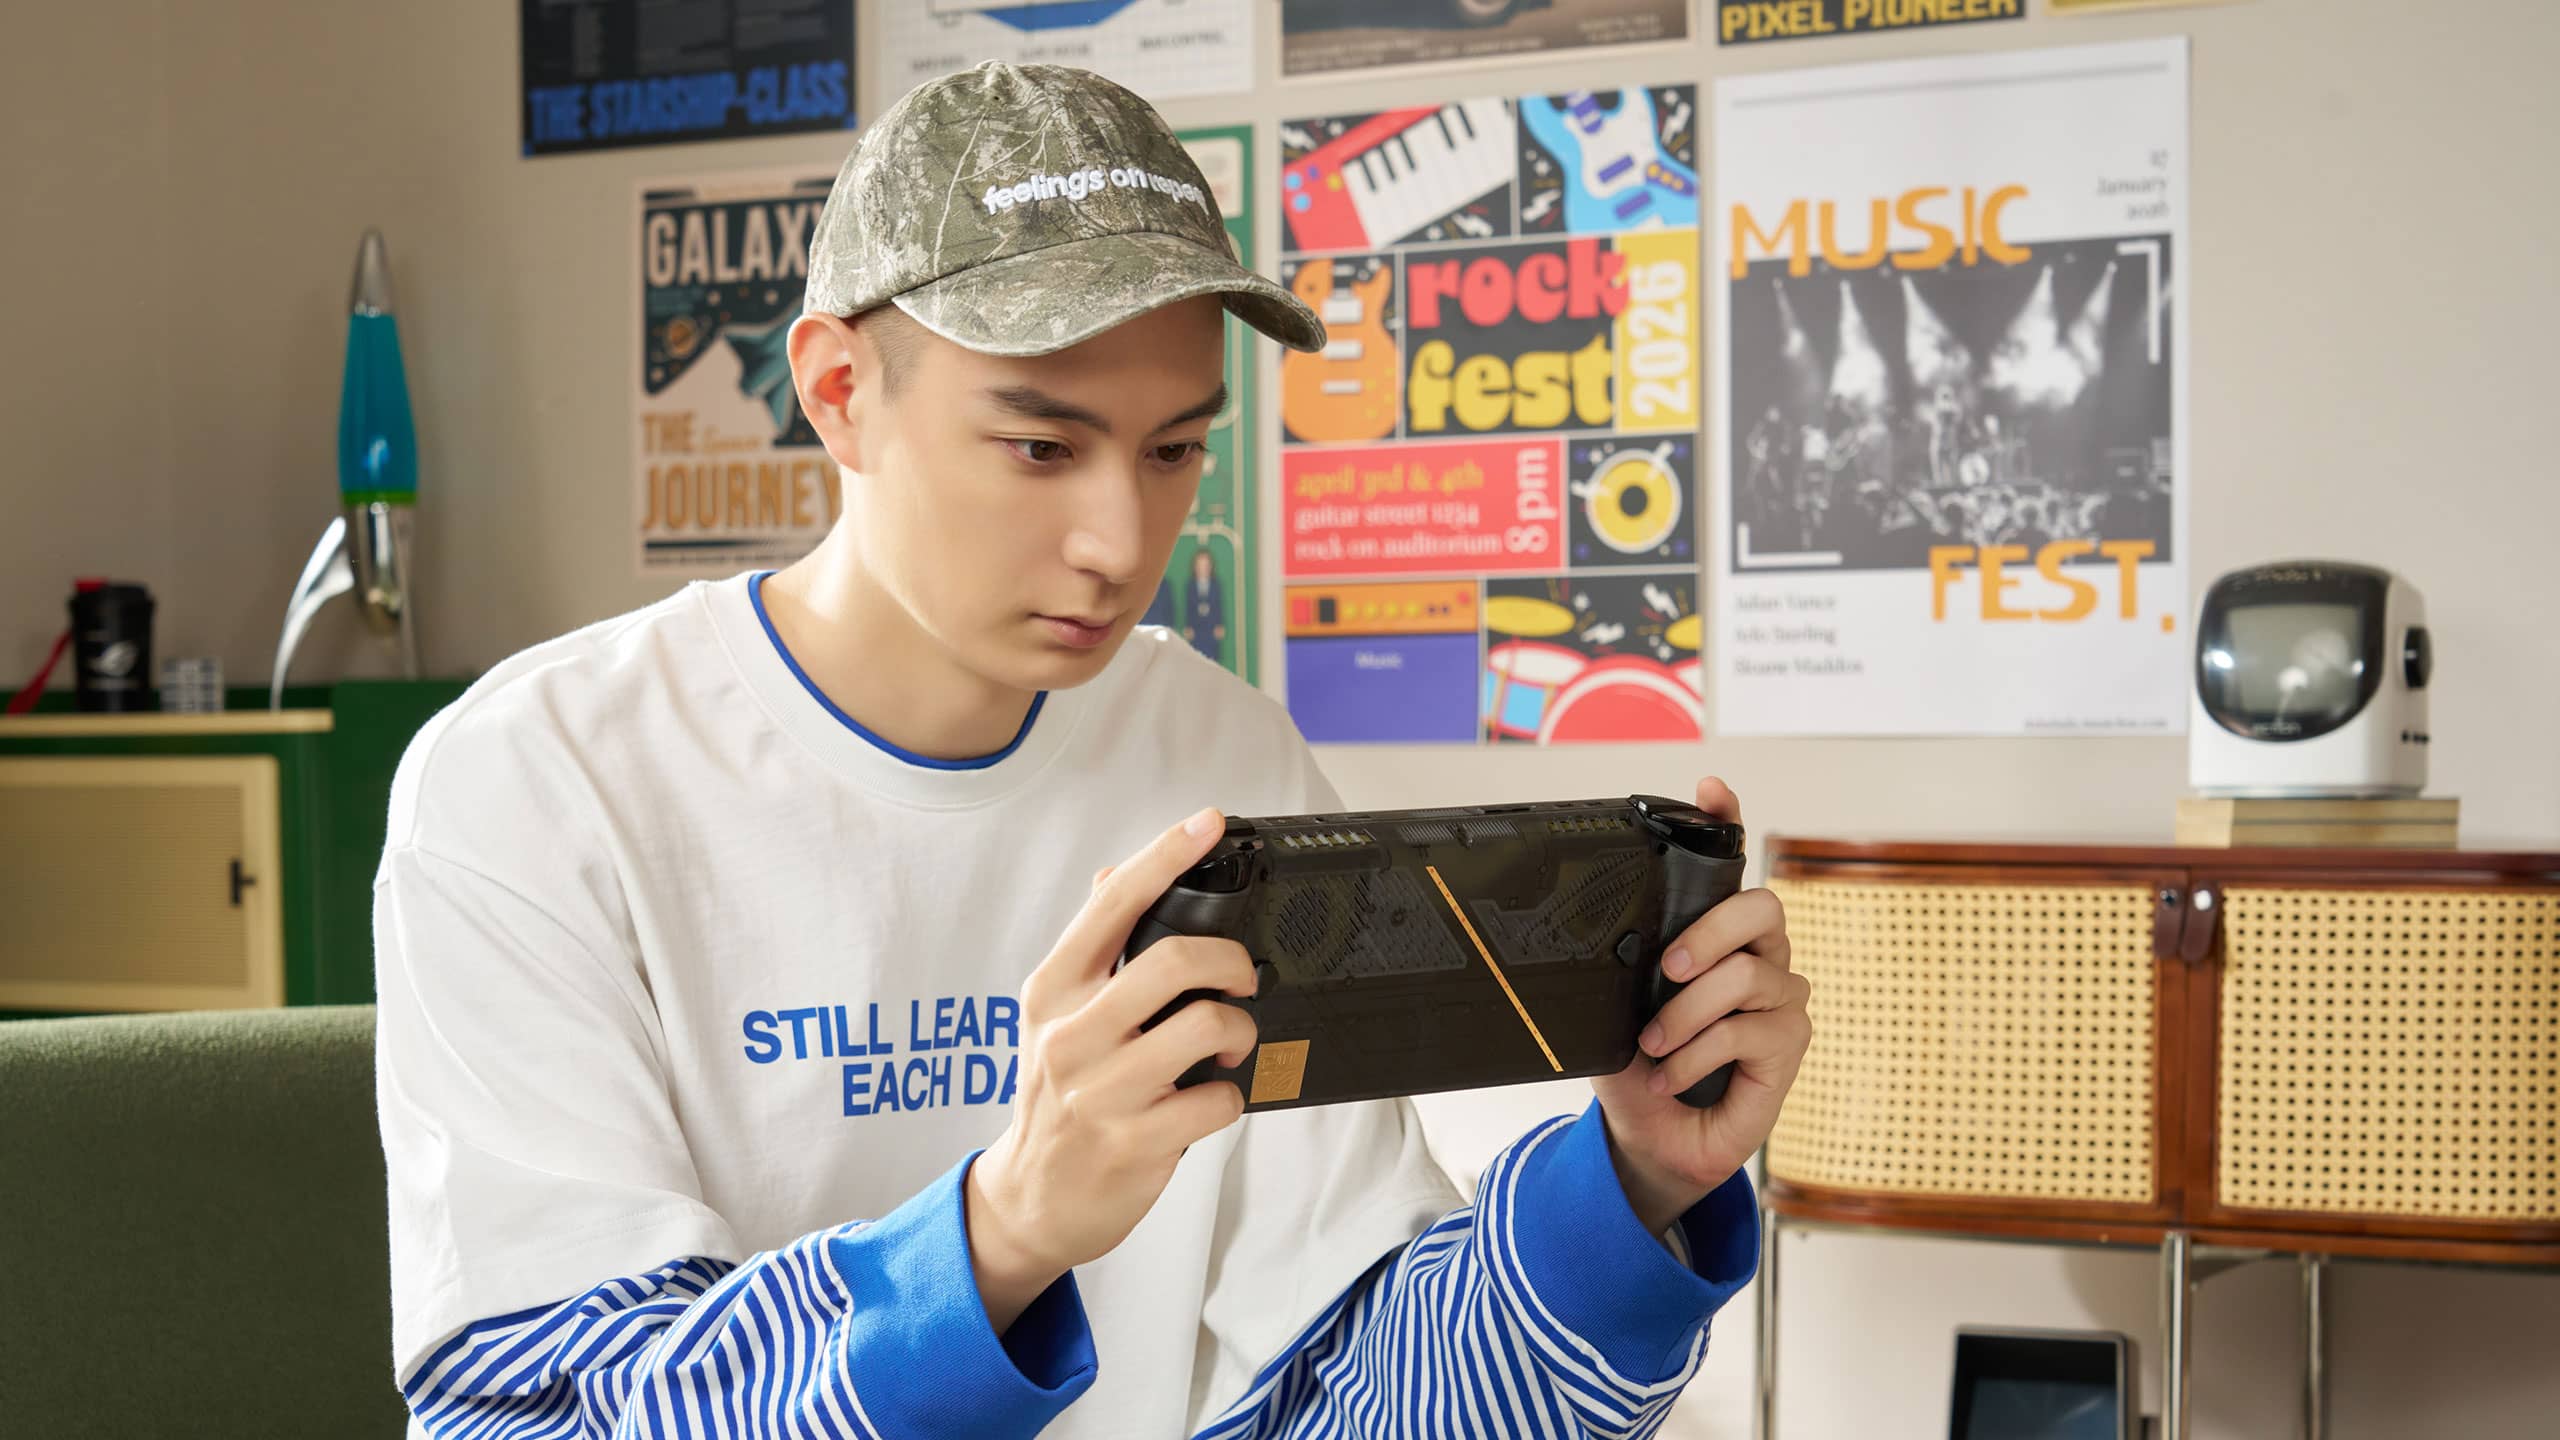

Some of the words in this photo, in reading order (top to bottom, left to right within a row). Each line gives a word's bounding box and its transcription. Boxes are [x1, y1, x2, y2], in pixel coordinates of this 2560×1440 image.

[1721, 0, 1835, 41] PIXEL
[1843, 0, 2018, 30] PIONEER
[530, 84, 583, 142] THE
[588, 60, 848, 139] STARSHIP-CLASS
[982, 168, 1106, 216] feelings
[1110, 167, 1148, 189] on
[1730, 184, 2032, 280] MUSIC
[1408, 236, 1631, 328] rock
[1628, 260, 1690, 418] 2026
[1408, 334, 1614, 432] fest
[642, 411, 693, 454] THE
[1295, 463, 1356, 502] april
[1408, 463, 1432, 492] &
[1381, 530, 1502, 559] auditorium
[1928, 540, 2176, 633] FEST.
[743, 1003, 893, 1064] STILL
[910, 996, 1020, 1051] LEAR
[842, 1055, 952, 1117] EACH
